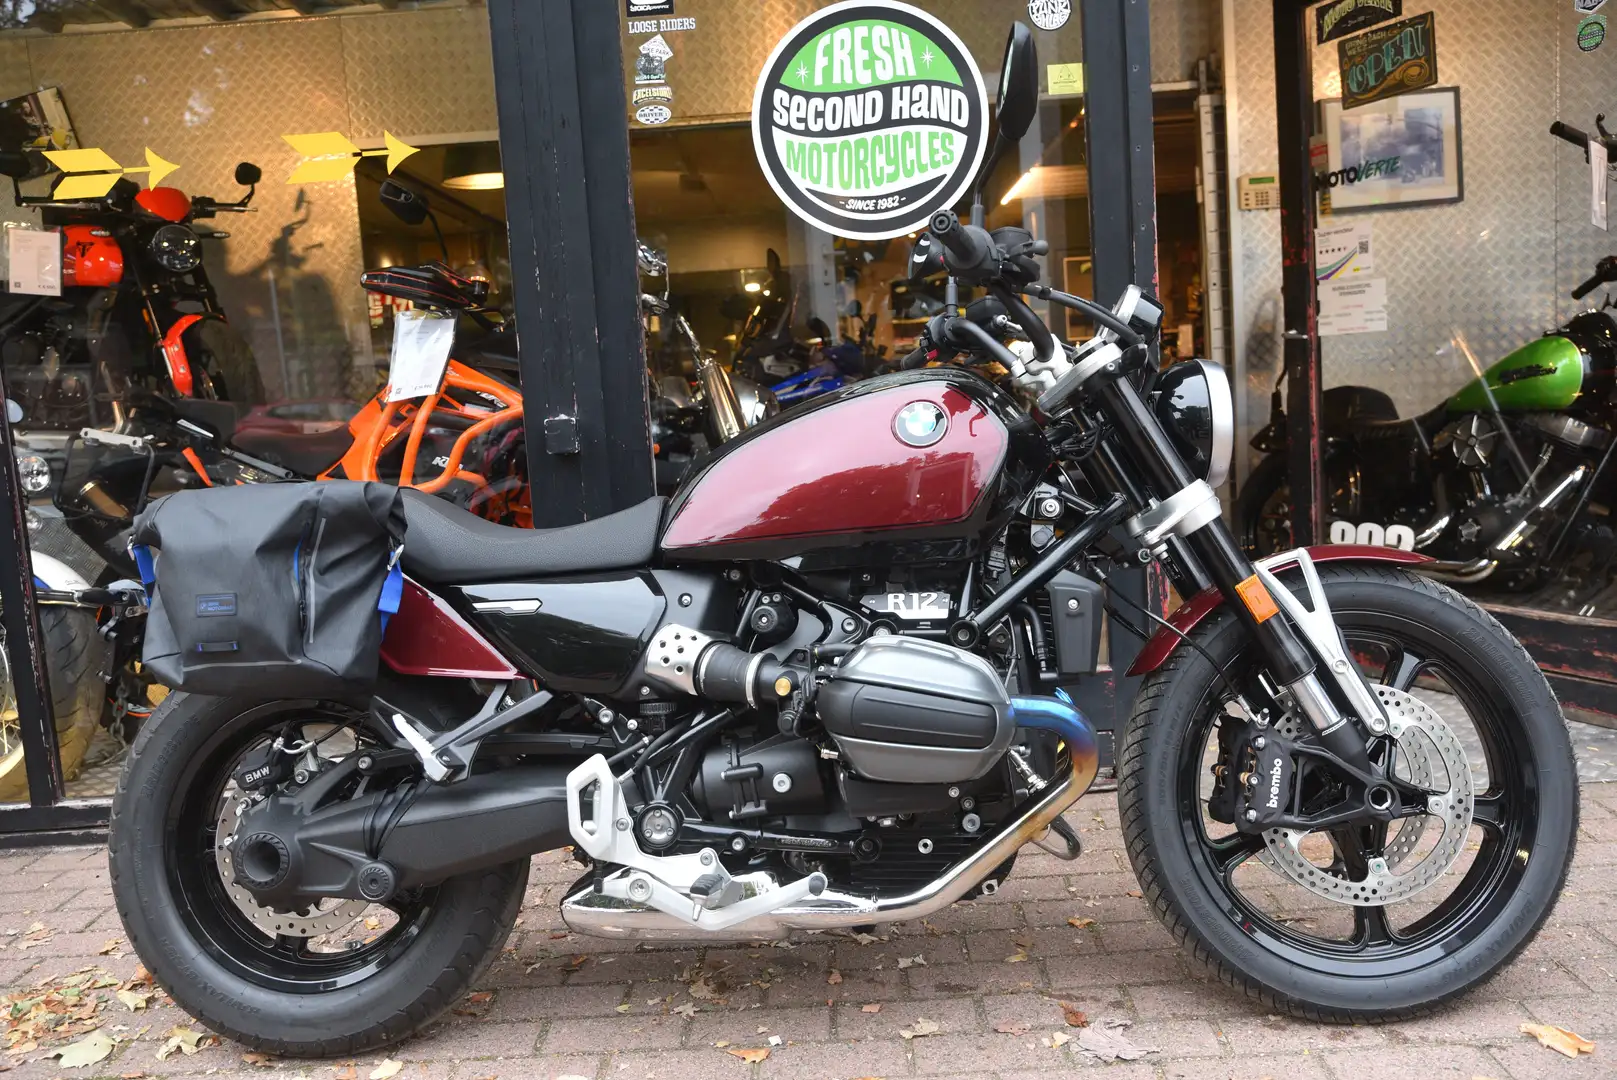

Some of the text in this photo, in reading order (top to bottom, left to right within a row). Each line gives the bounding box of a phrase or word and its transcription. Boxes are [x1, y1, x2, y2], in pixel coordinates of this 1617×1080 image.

[1031, 0, 1071, 15] PUNK
[627, 17, 696, 34] LOOSE RIDERS
[813, 25, 917, 87] FRESH
[1347, 23, 1427, 93] OPEN
[785, 130, 955, 190] MOTORCYCLES
[1315, 155, 1400, 191] OTOVERTE
[845, 195, 900, 211] SINCE 1982
[887, 591, 939, 611] R12
[244, 765, 270, 783] BMW
[1265, 757, 1283, 809] brembo
